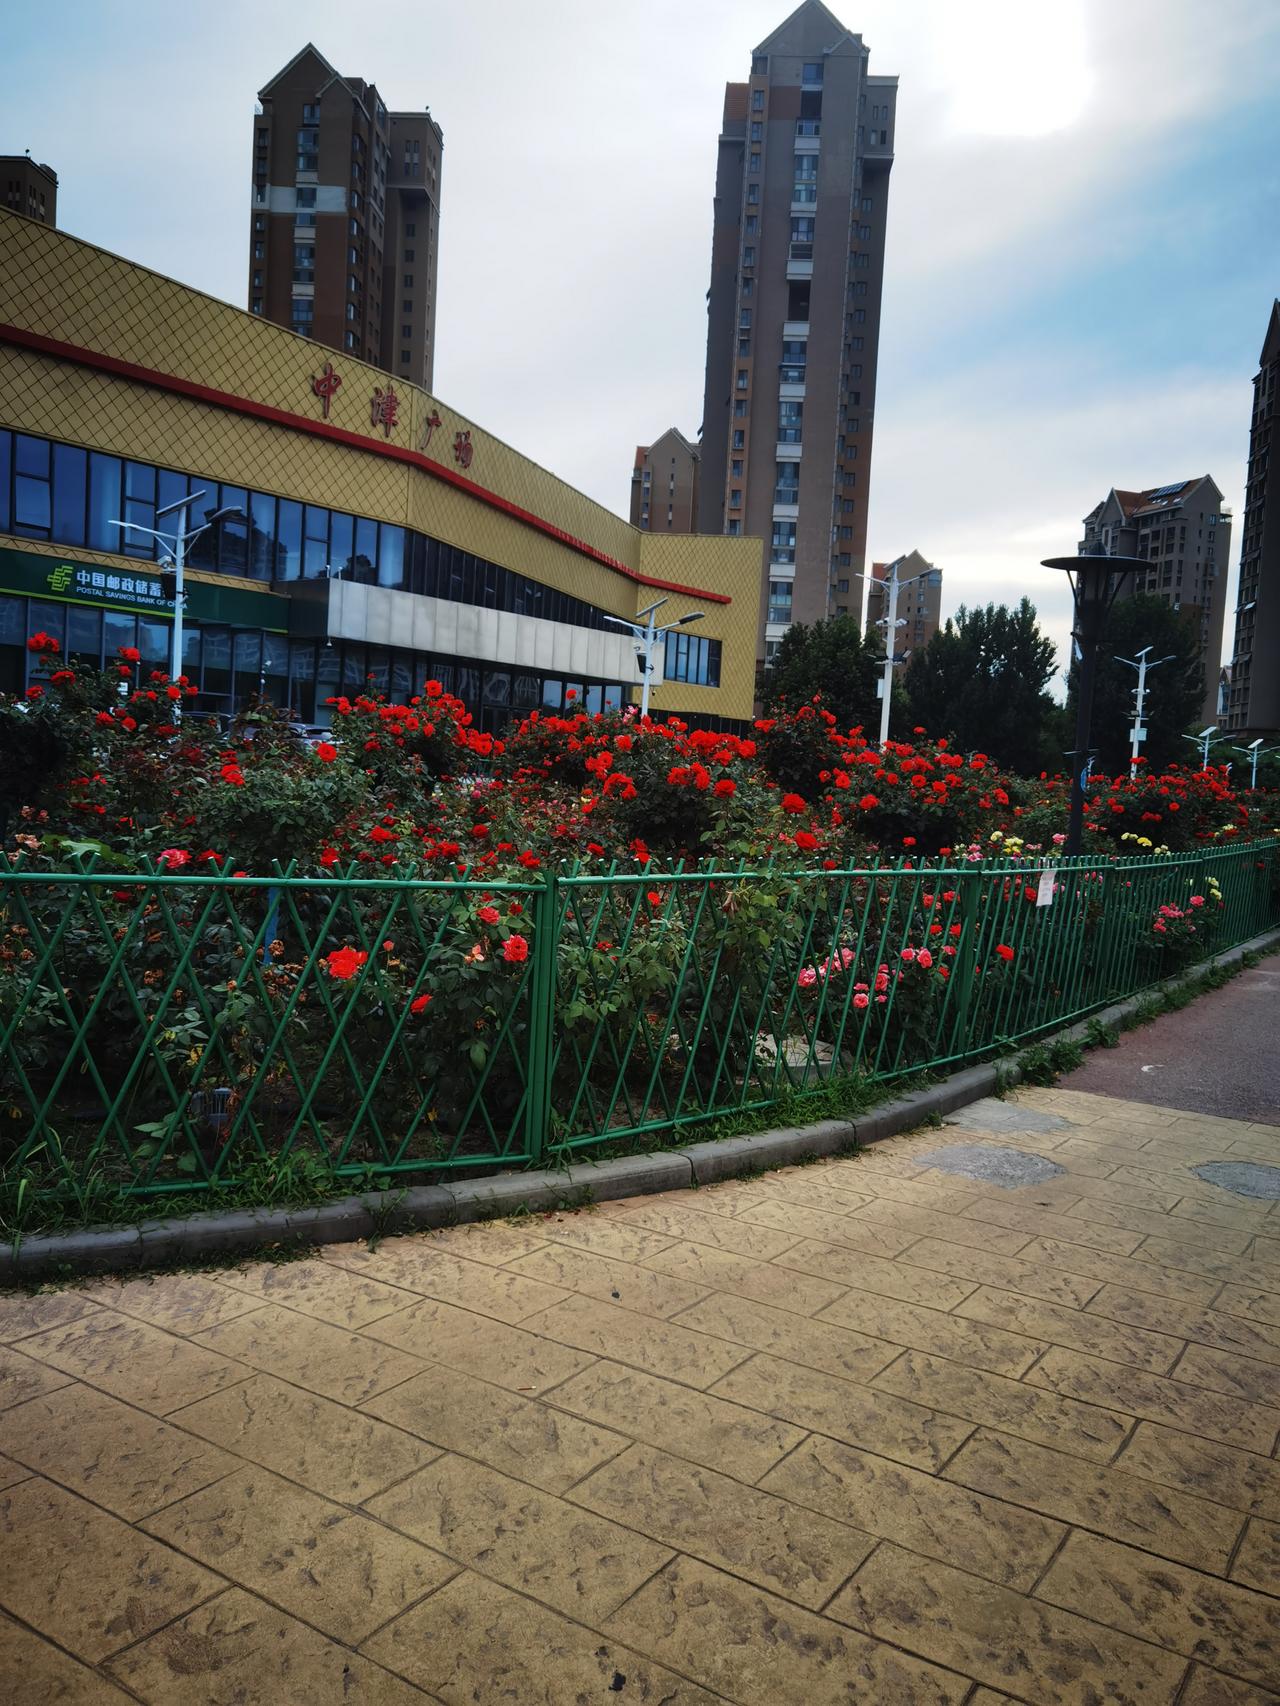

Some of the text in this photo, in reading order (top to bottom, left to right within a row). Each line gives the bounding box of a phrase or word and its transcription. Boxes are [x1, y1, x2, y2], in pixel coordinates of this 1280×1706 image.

[76, 570, 189, 600] 中国邮政储蓄
[76, 586, 104, 597] POSTAL
[105, 591, 136, 602] SAVINGS
[137, 596, 155, 605] BANK
[167, 600, 188, 609] CHA
